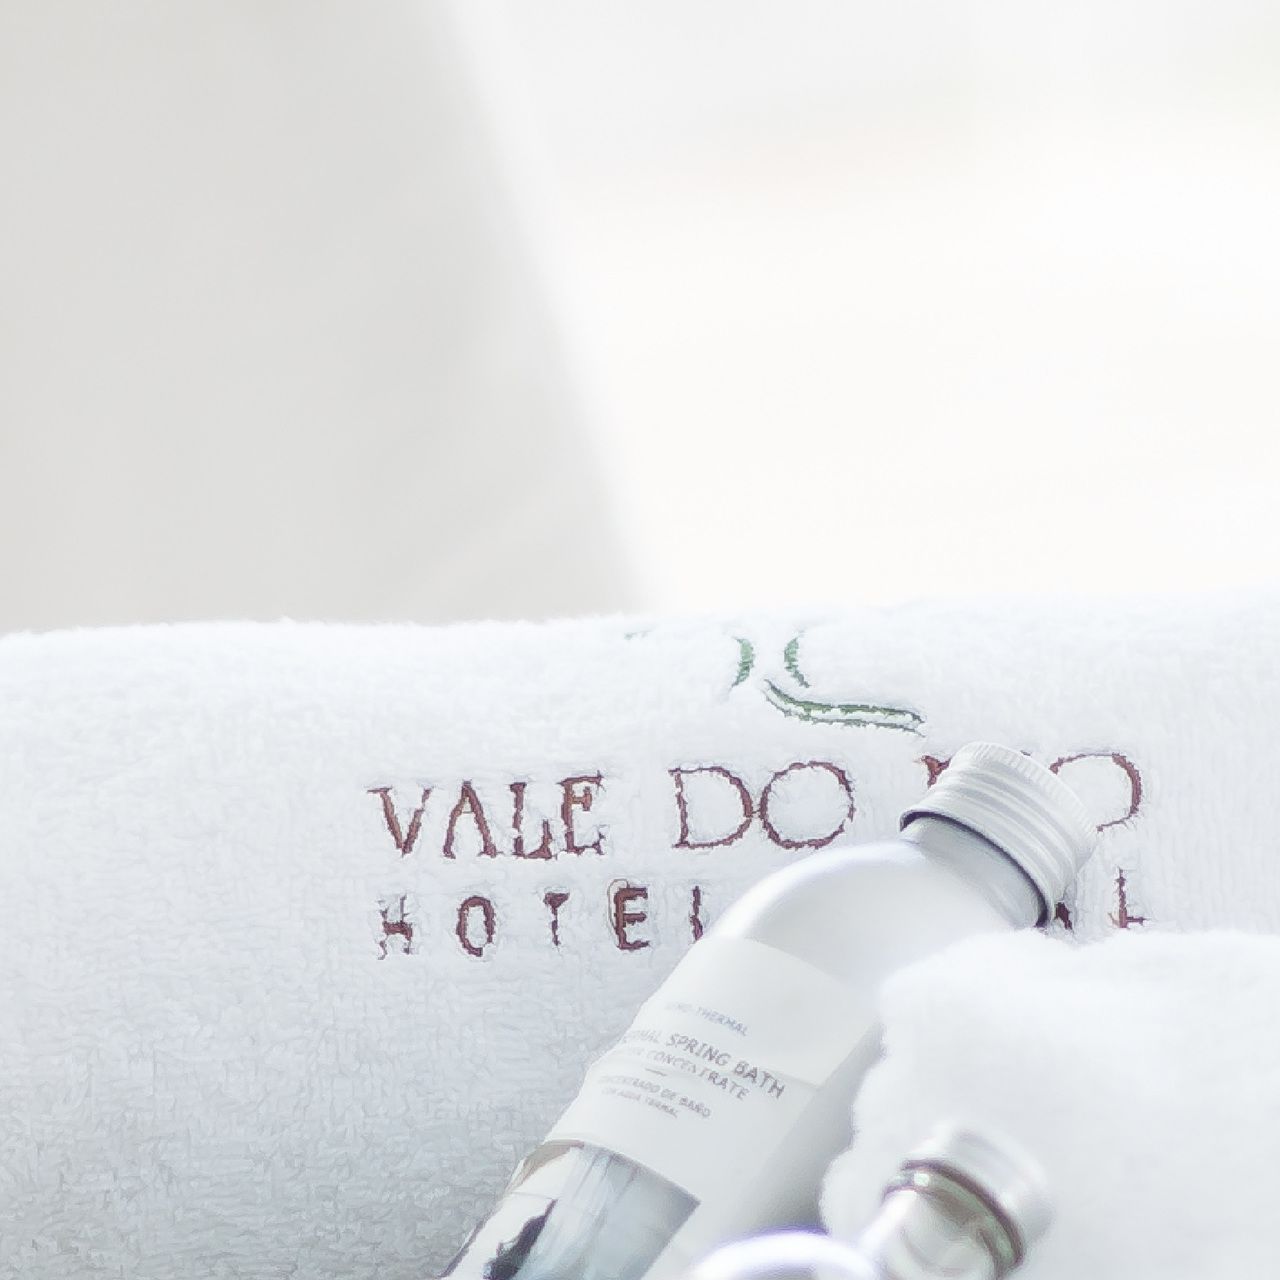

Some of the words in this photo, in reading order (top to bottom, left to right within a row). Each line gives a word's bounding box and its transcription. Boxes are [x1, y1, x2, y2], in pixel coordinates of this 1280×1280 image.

[368, 770, 607, 860] VALE
[667, 760, 856, 850] DO
[665, 1032, 732, 1067] SPRING
[733, 1060, 786, 1100] BATH
